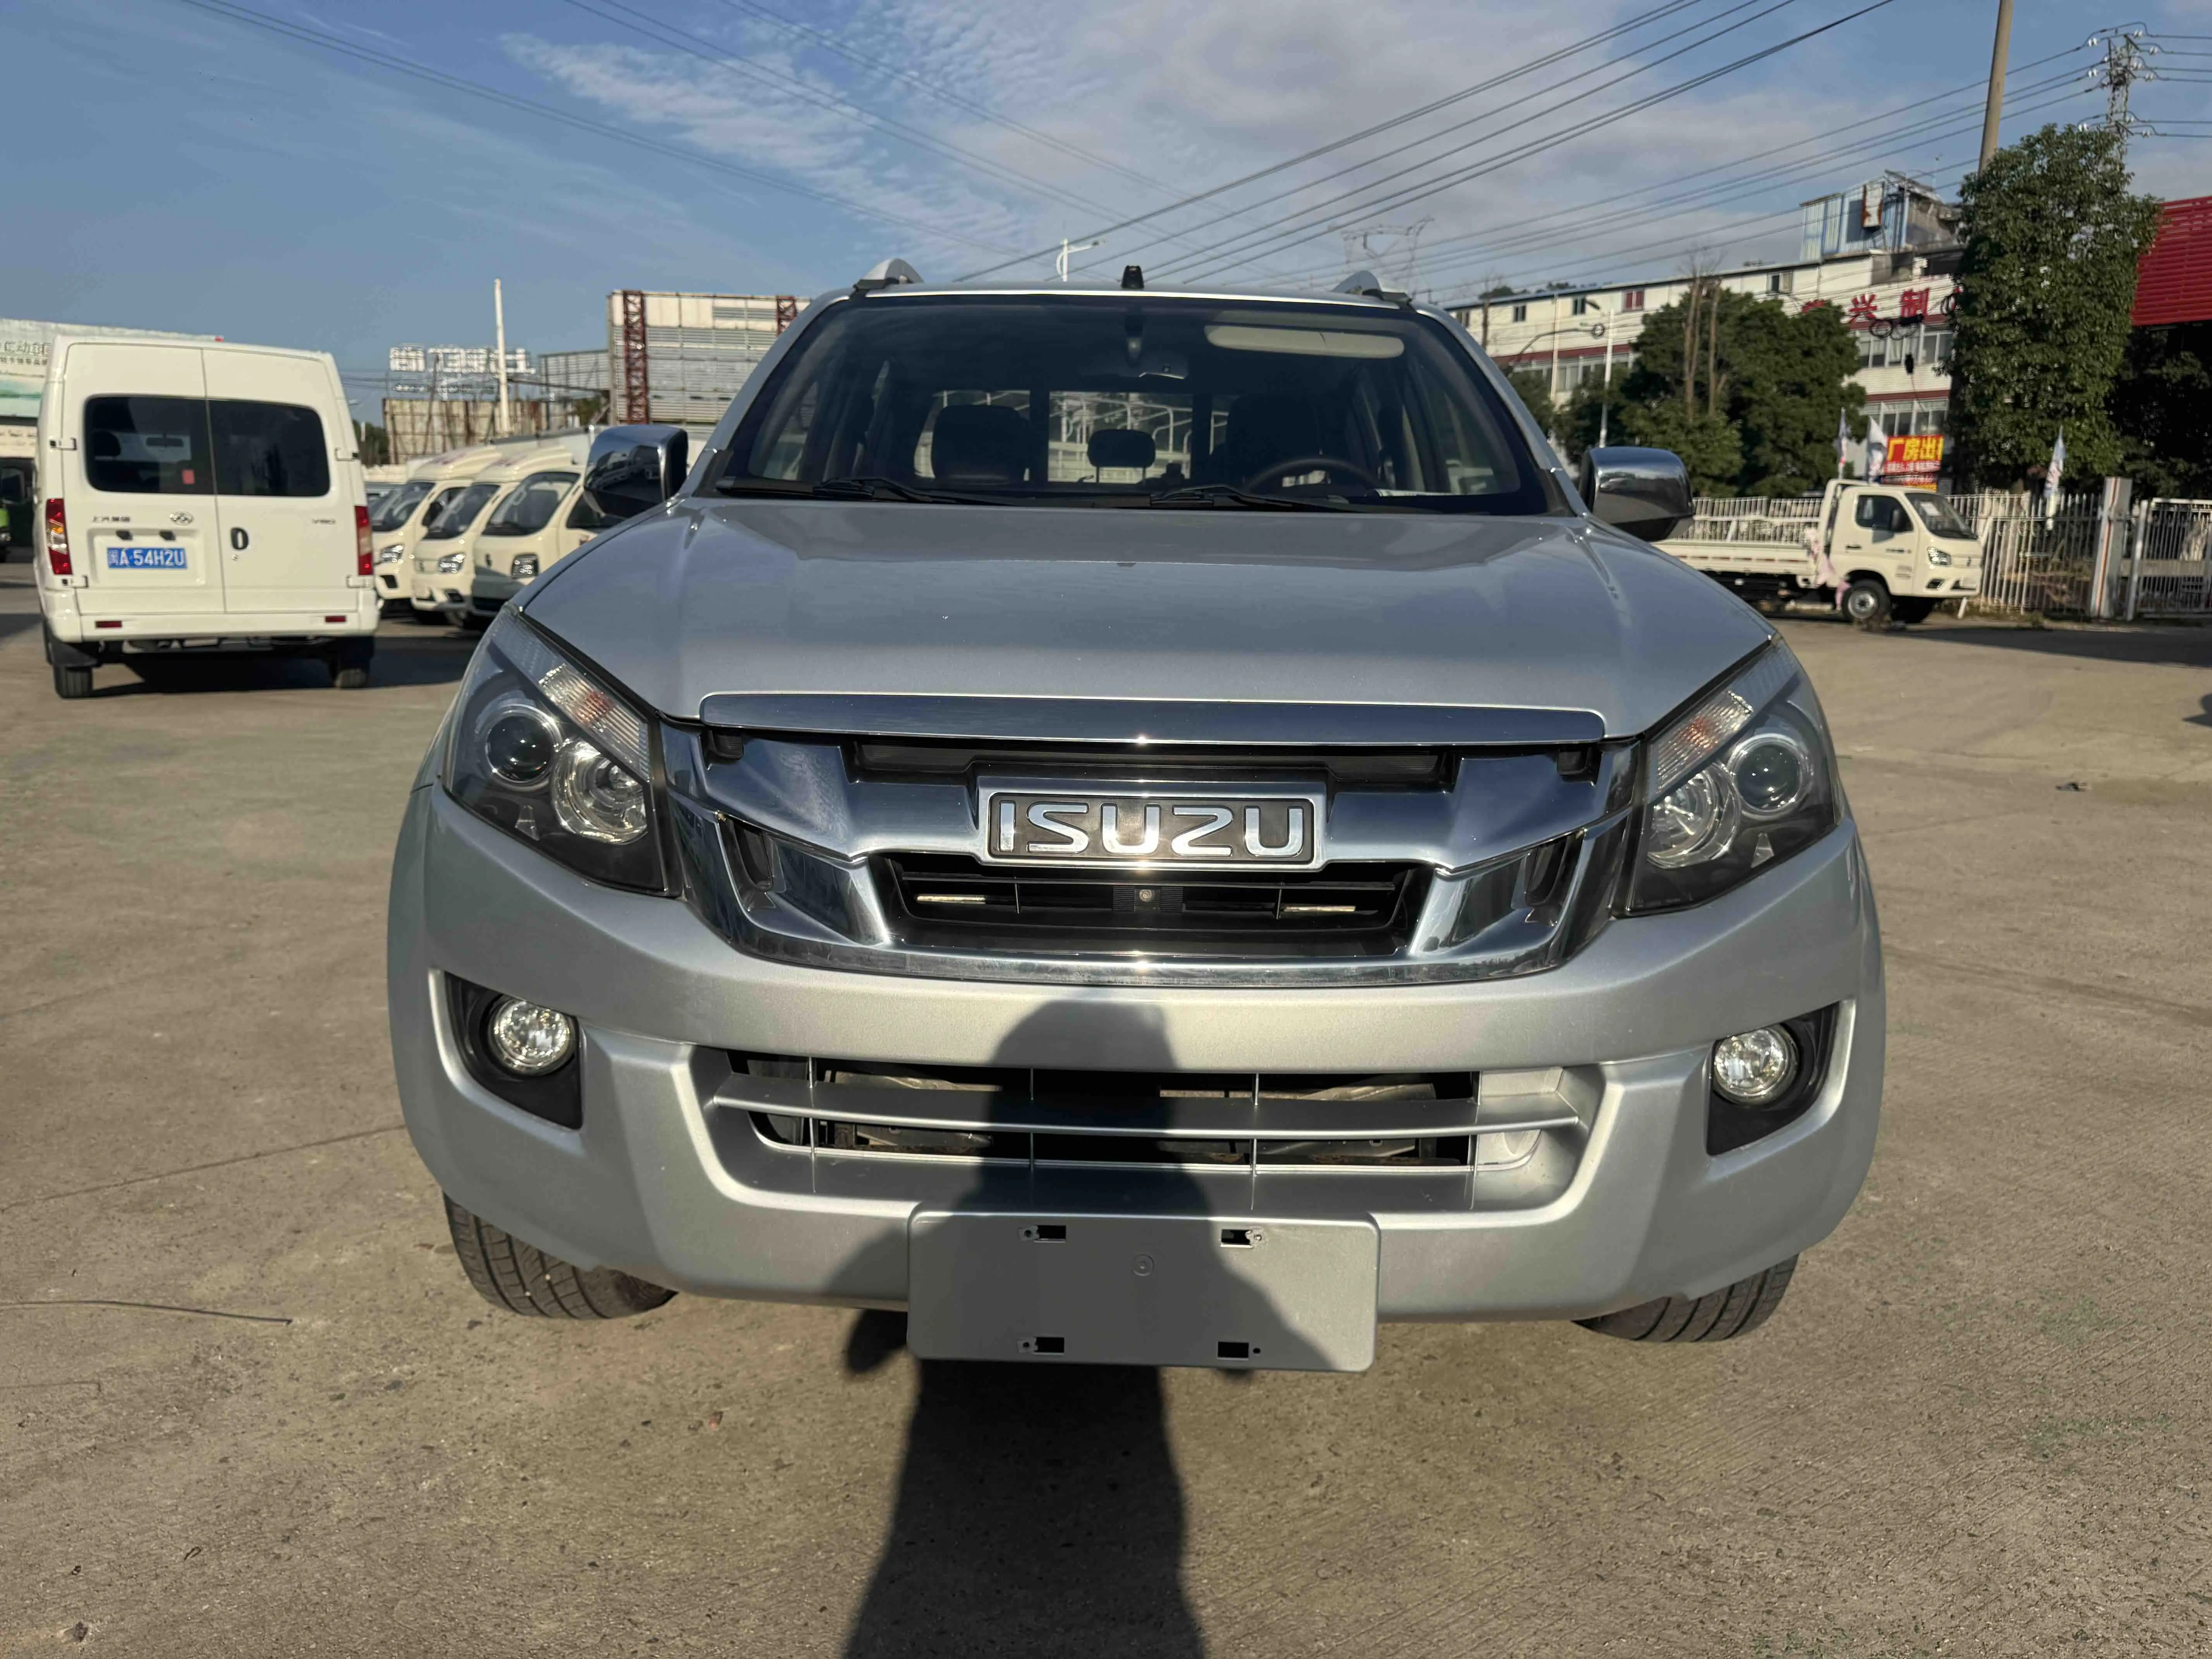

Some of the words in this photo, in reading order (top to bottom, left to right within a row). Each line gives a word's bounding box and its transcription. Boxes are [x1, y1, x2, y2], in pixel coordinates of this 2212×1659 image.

[1887, 436, 1944, 461] 厂房出
[998, 800, 1304, 857] ISUZU
